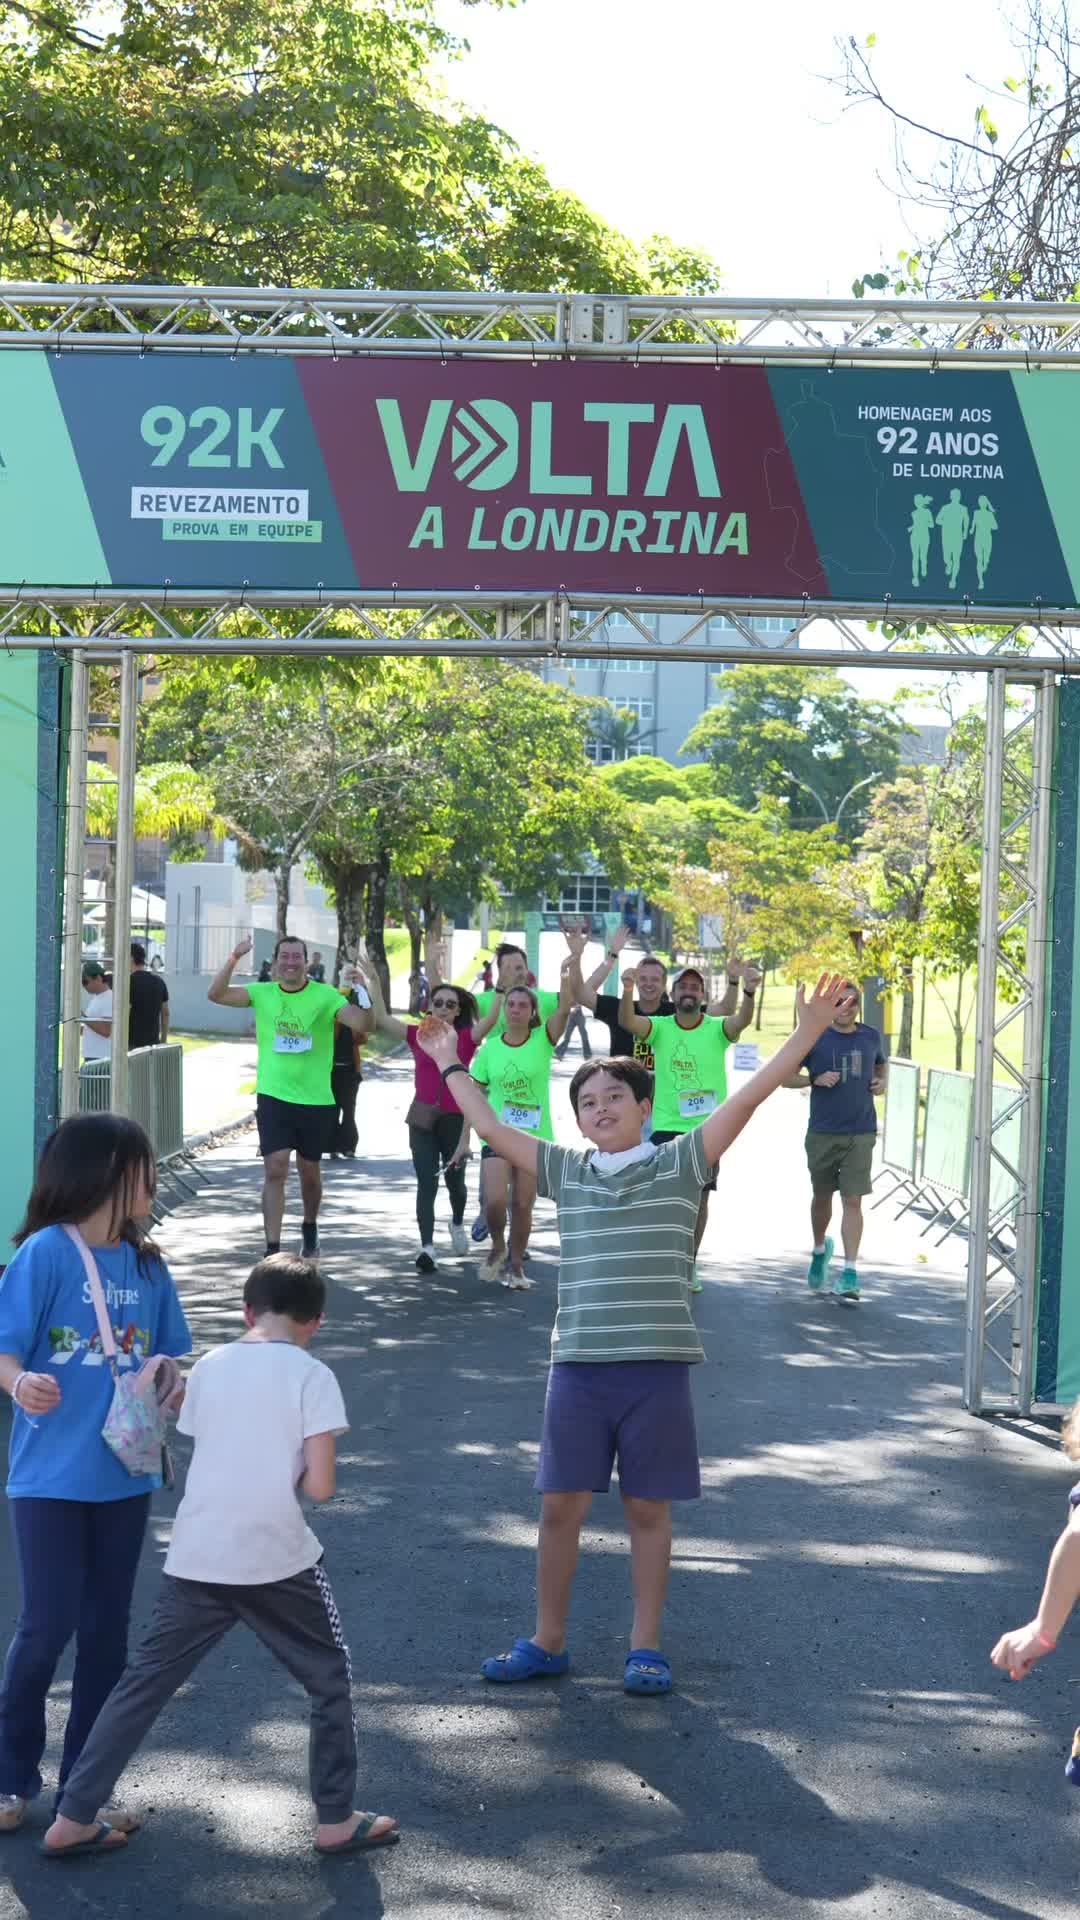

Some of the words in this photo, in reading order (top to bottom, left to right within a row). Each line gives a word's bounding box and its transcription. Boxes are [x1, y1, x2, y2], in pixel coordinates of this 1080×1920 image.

[858, 405, 953, 422] HOMENAGEM
[959, 407, 992, 423] AOS
[140, 405, 285, 469] 92K
[877, 426, 918, 454] 92
[925, 431, 999, 457] ANOS
[375, 398, 722, 498] VOLTA
[893, 462, 913, 478] DE
[920, 463, 1005, 480] LONDRINA
[140, 494, 300, 514] REVEZAMENTO
[172, 522, 220, 536] PROVA
[229, 523, 249, 537] EM
[258, 524, 314, 539] EQUIPE
[408, 506, 445, 549] A
[467, 506, 749, 556] LONDRINA
[281, 1037, 300, 1046] 206
[687, 1096, 705, 1106] 206
[510, 1107, 529, 1119] 206
